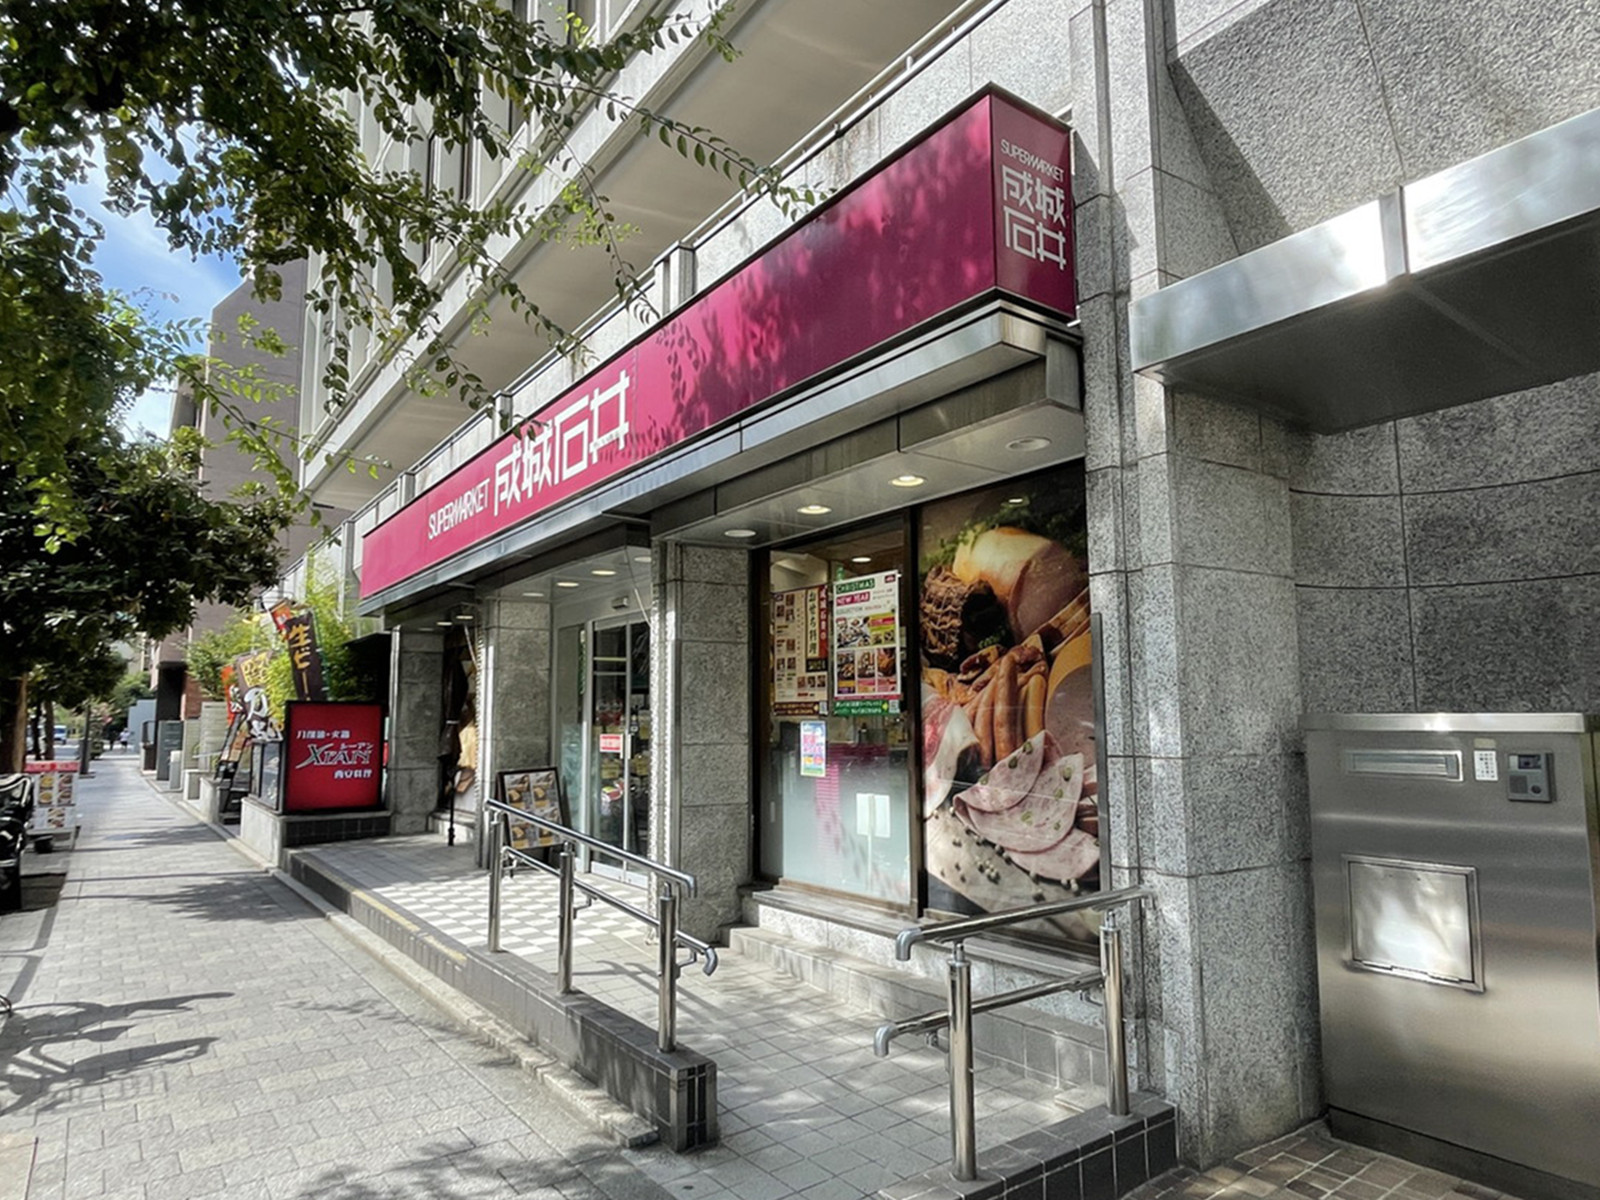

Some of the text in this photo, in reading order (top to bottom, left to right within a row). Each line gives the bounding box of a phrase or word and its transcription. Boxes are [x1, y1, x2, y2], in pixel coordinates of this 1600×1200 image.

[1000, 138, 1064, 183] SUPERMARKET
[1002, 164, 1067, 228] 成城
[1003, 204, 1067, 271] 石井
[427, 369, 630, 540] SUPERMARKET 成城石井
[837, 579, 875, 593] CHRISTMAS
[837, 595, 853, 606] NEW
[853, 592, 869, 604] YEAR
